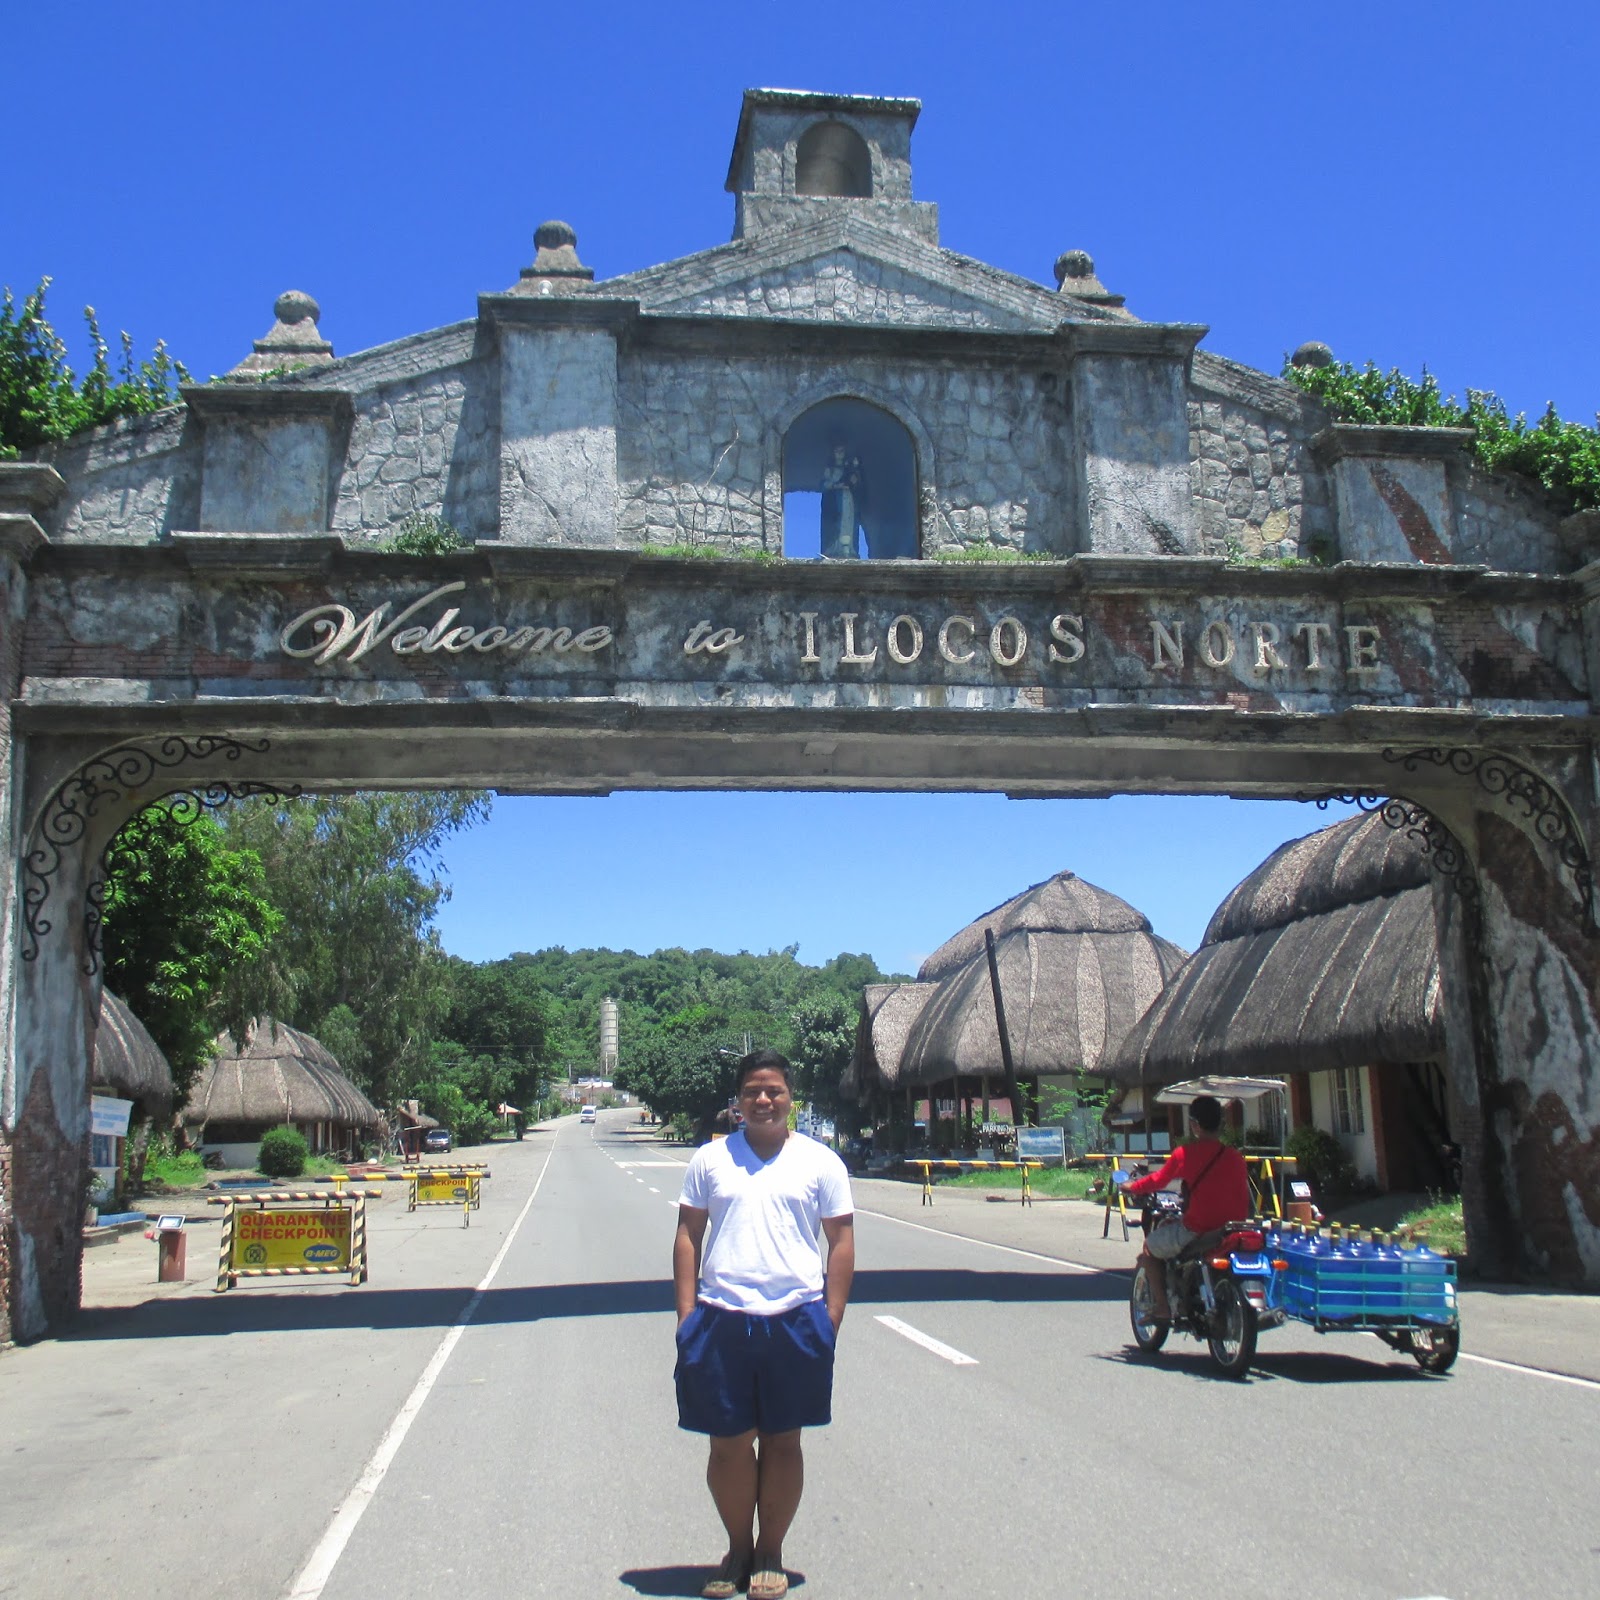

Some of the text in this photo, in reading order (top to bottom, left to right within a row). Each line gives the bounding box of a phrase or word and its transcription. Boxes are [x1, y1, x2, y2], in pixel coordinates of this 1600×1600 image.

[280, 580, 1384, 675] Welcome to ILOCOS NORTE
[241, 1214, 346, 1226] QUARANTINE
[240, 1228, 345, 1239] CHECKPOINT
[306, 1250, 337, 1258] B-MEG
